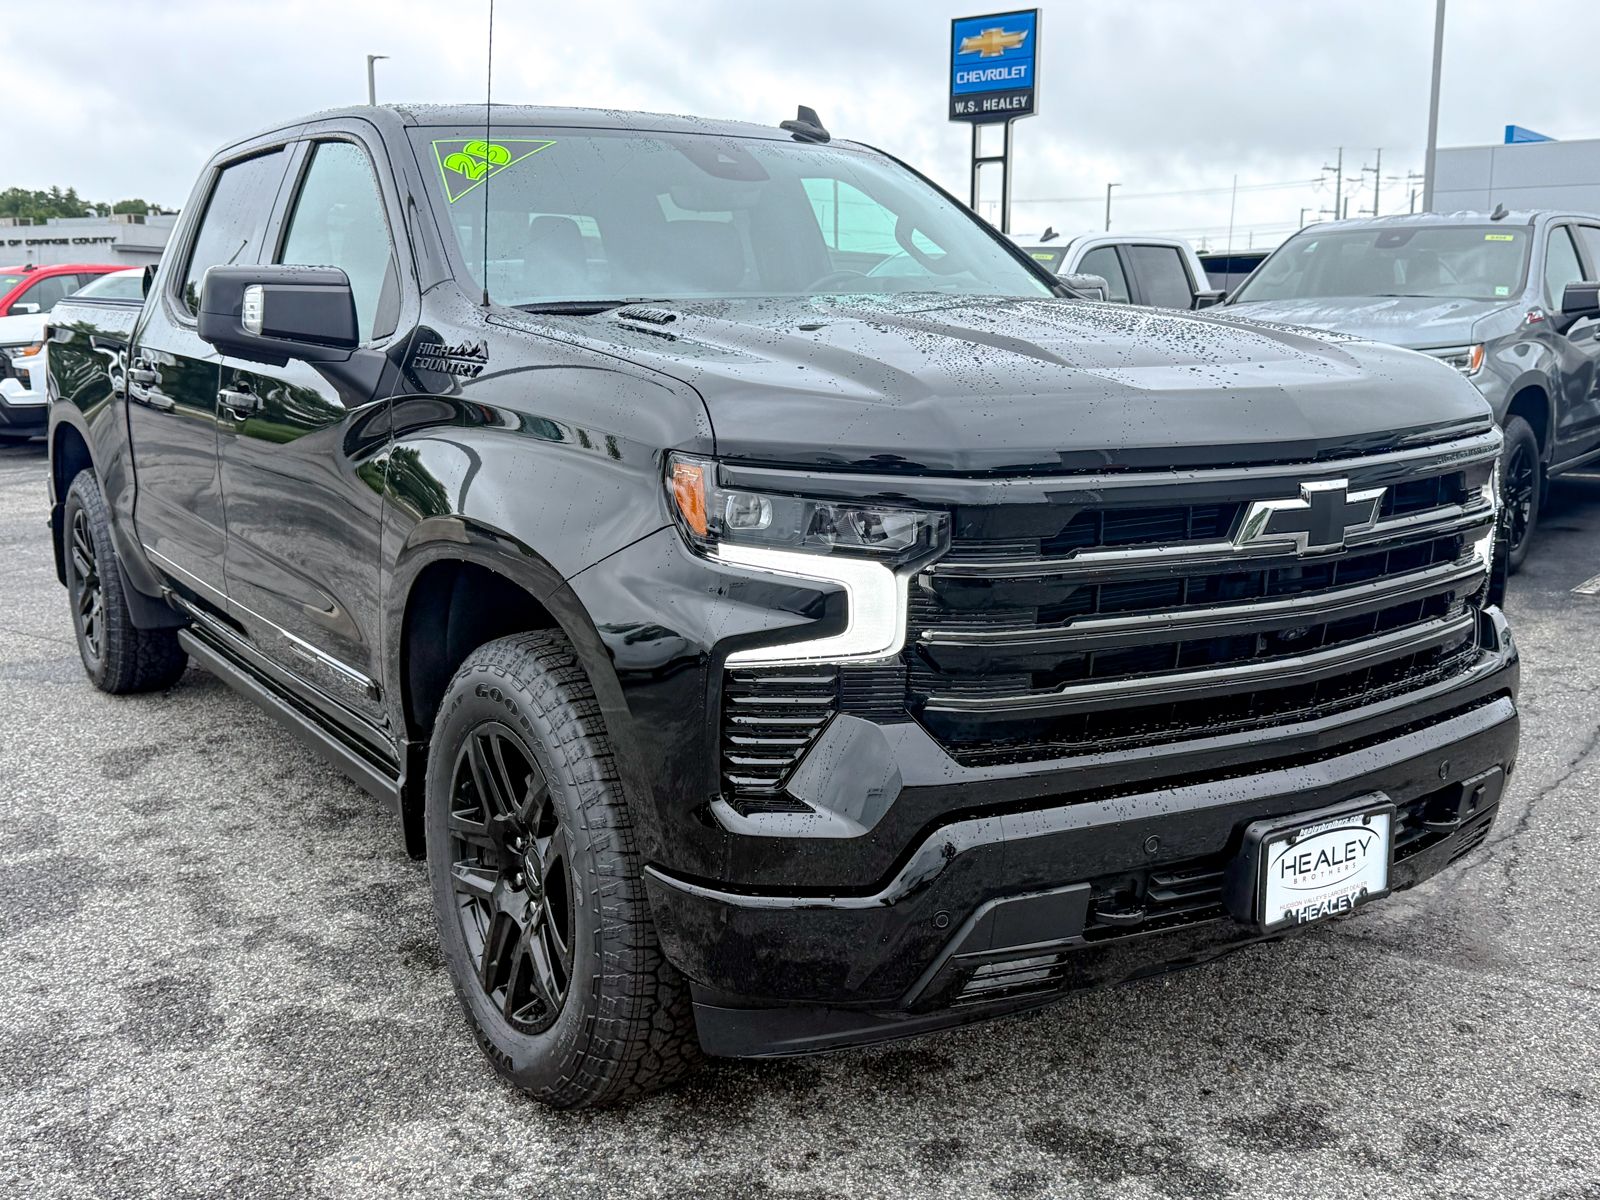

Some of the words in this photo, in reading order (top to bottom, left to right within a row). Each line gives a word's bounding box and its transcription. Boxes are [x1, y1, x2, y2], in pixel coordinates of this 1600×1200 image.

[956, 65, 1027, 84] CHEVROLET
[955, 101, 979, 113] W.S.
[983, 96, 1028, 111] HEALEY
[25, 238, 69, 246] ORANGE
[72, 237, 117, 245] COUNTY
[416, 342, 449, 356] HIGH
[412, 356, 484, 378] COUNTRY
[1281, 836, 1372, 879] HEALEY
[1293, 862, 1357, 884] BROTHERS
[1298, 892, 1356, 924] HEALEY
